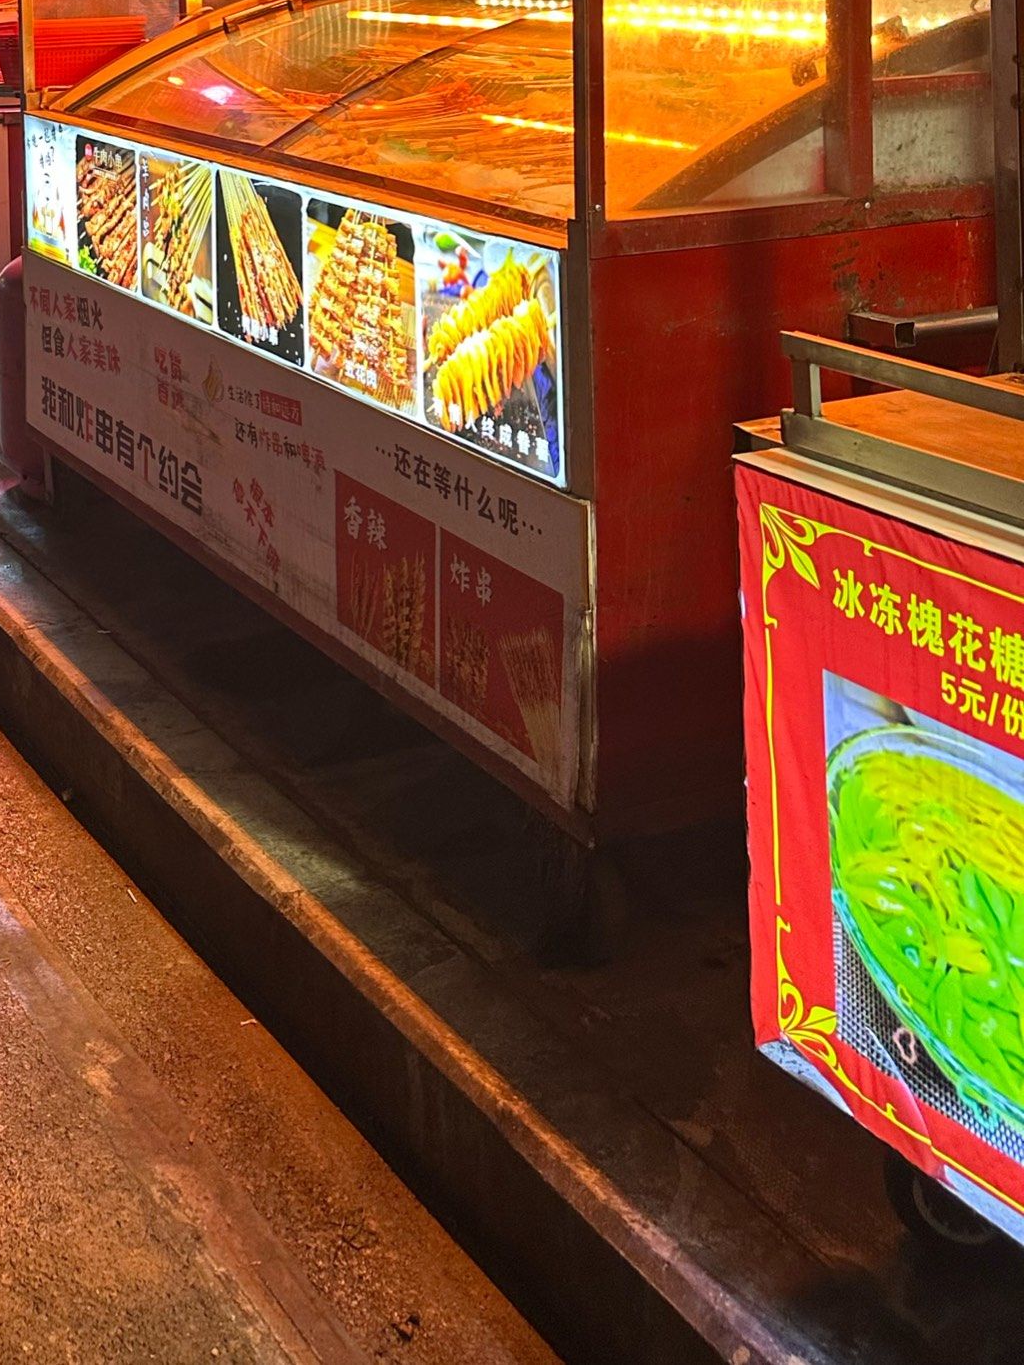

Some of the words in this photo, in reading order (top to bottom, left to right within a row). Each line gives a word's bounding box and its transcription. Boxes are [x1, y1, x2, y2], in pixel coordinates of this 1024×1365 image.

[29, 286, 103, 332] 不闻人家烟火
[42, 325, 121, 375] 但食人家美味
[41, 376, 202, 516] 我和炸串有个约会
[344, 495, 388, 551] 香辣
[451, 553, 493, 607] 炸串
